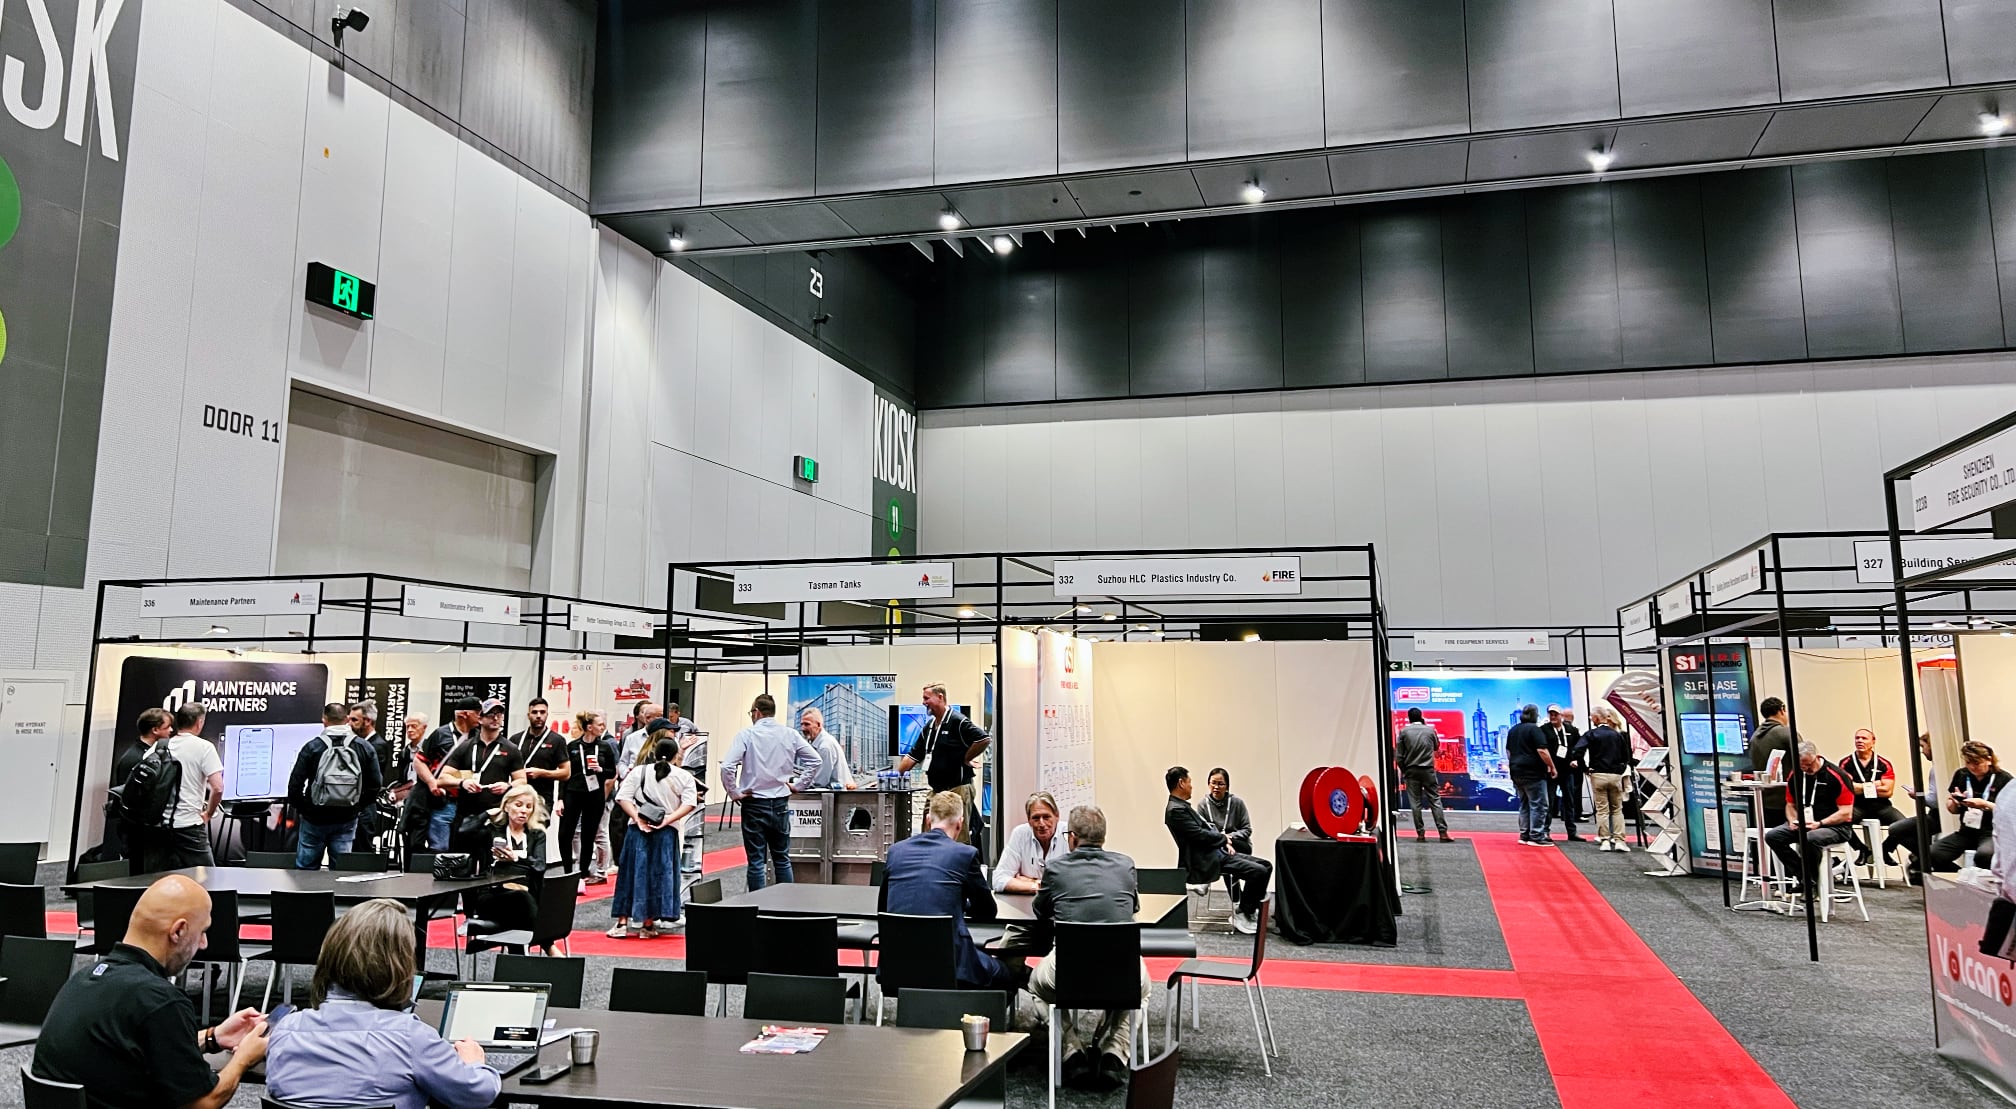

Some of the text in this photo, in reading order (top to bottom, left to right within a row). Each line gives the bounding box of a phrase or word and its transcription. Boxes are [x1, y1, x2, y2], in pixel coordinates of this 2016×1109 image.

[0, 0, 123, 161] SK
[810, 267, 823, 298] 23
[203, 404, 280, 443] DOOR 11
[874, 395, 916, 494] KIOSK
[1963, 453, 1995, 480] SHENZHEN
[1947, 489, 1960, 507] FIRE
[1960, 477, 1989, 502] SECURITY
[1863, 558, 1884, 569] 327
[1901, 557, 1943, 570] Building
[1058, 573, 1237, 585] 332 Suzhou HLC Plastics Industry Co.
[1272, 570, 1295, 579] FIRE
[738, 580, 862, 592] 333 Tasman Tanks
[143, 597, 256, 607] 336 Maintenance Partners
[439, 601, 466, 611] Maintenance
[466, 604, 484, 613] Partners
[1675, 655, 1697, 671] S1
[202, 680, 297, 696] MAINTENANCE
[1716, 680, 1738, 691] ASE
[202, 697, 268, 712] PARTNERS
[385, 683, 397, 742] PARTNERS
[392, 683, 406, 768] MAINTENANCE
[799, 817, 822, 826] TANKS
[1936, 933, 2013, 1007] Volcano
